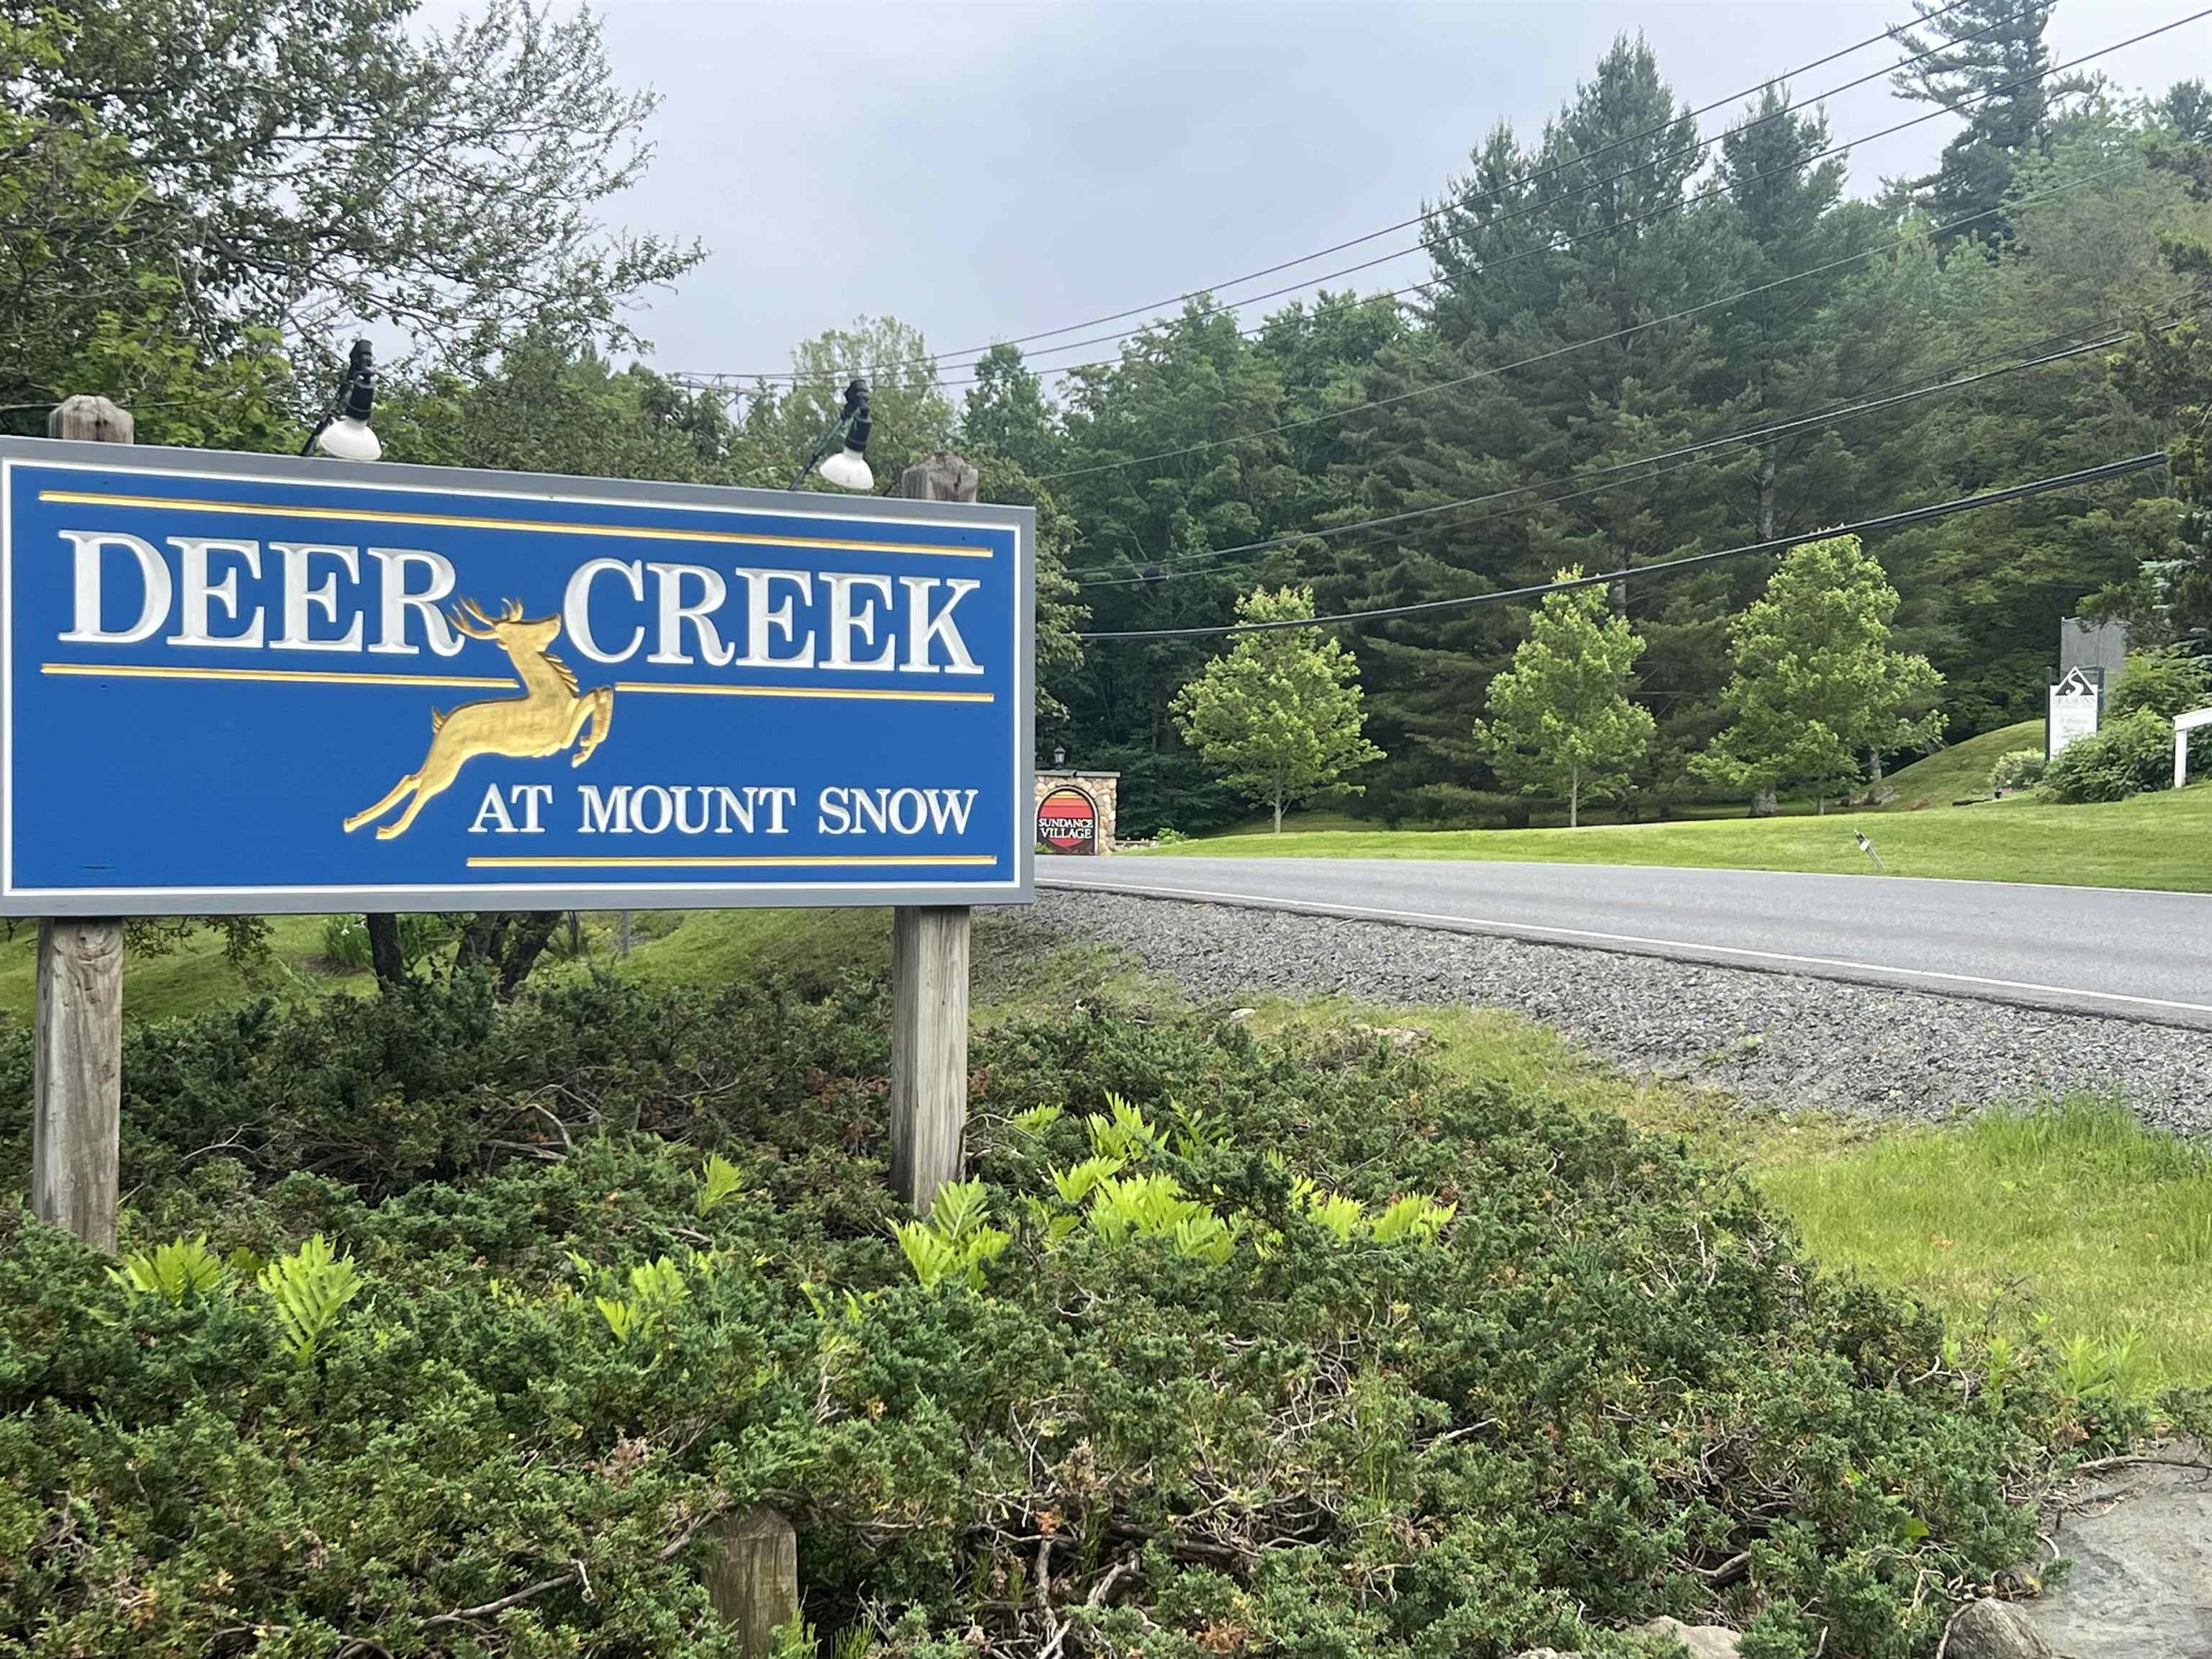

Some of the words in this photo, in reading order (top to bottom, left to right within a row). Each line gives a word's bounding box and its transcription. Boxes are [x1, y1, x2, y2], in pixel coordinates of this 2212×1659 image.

[58, 529, 465, 657] DEER
[564, 557, 984, 675] CREEK
[467, 782, 553, 833] AT
[577, 784, 796, 834] MOUNT
[818, 787, 979, 835] SNOW
[1038, 818, 1094, 828] SUNDANCE
[1040, 827, 1093, 839] VILLAGE
